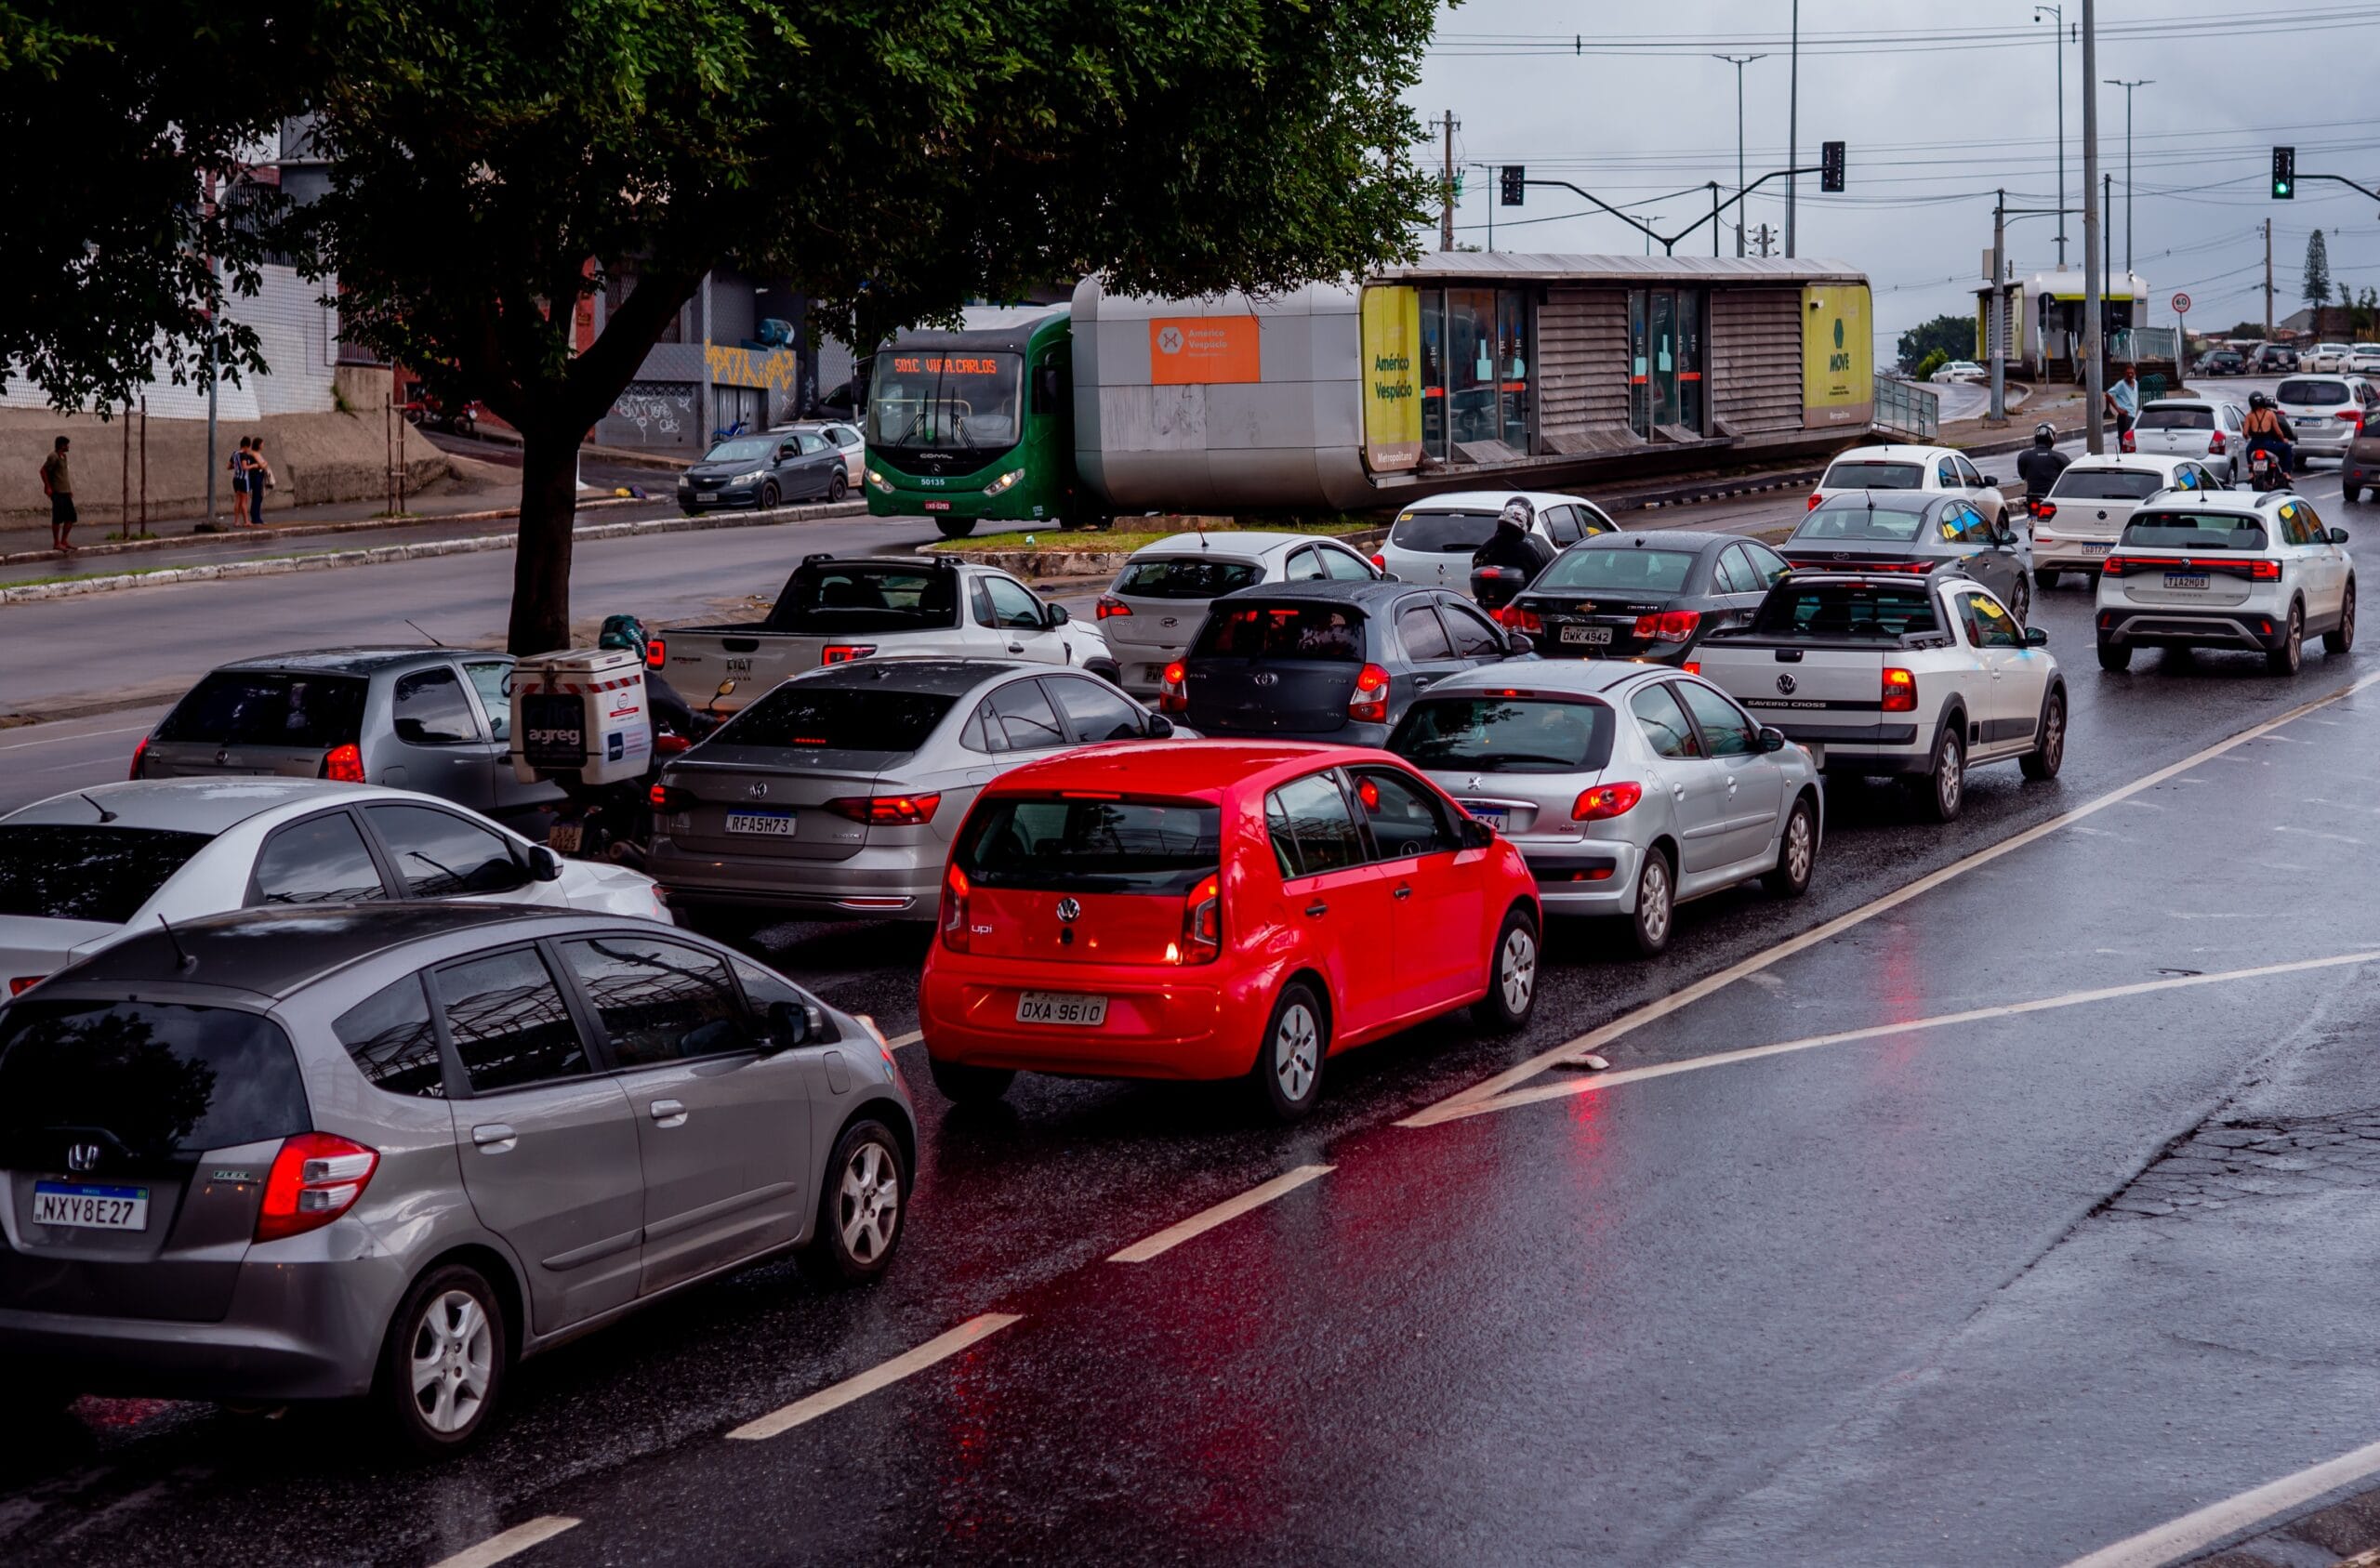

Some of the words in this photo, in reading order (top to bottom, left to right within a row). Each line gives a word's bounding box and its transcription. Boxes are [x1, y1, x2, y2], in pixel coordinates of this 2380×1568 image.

[1375, 352, 1409, 372] Américo
[1830, 352, 1850, 373] MOVE
[1375, 379, 1412, 402] Vespúcio
[1377, 451, 1413, 466] Metropolitano
[920, 478, 945, 486] 50135
[726, 658, 753, 671] FIAT
[528, 729, 581, 745] agreg
[732, 816, 789, 833] RFA5H73
[43, 1196, 134, 1226] NXY8E27
